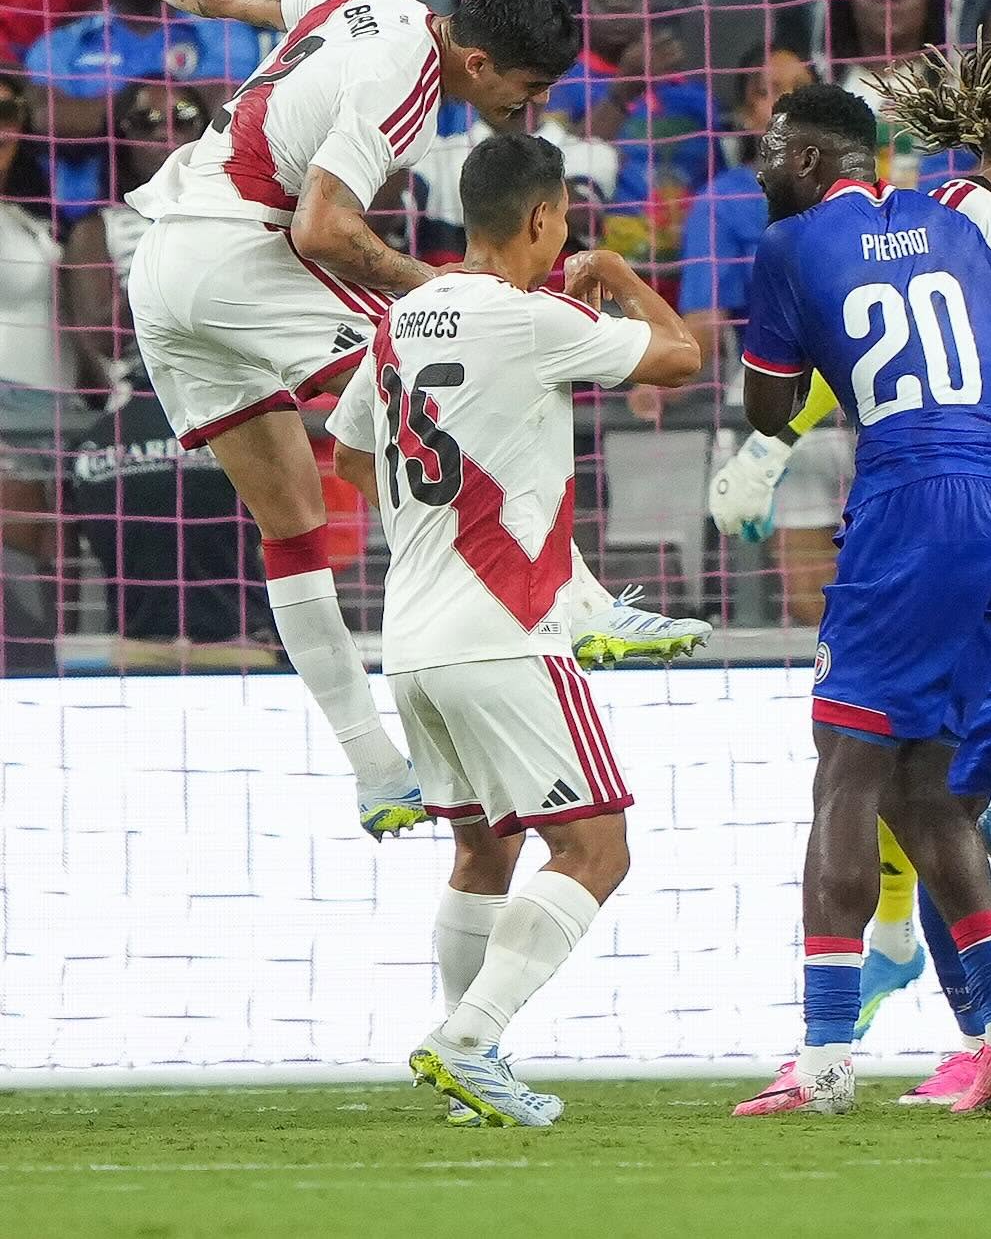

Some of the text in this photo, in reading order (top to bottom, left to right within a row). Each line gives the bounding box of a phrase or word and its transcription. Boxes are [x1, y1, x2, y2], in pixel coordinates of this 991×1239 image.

[861, 227, 929, 262] PIERROT
[395, 305, 461, 340] GARCÉS
[842, 271, 983, 427] 20
[378, 362, 466, 510] 15
